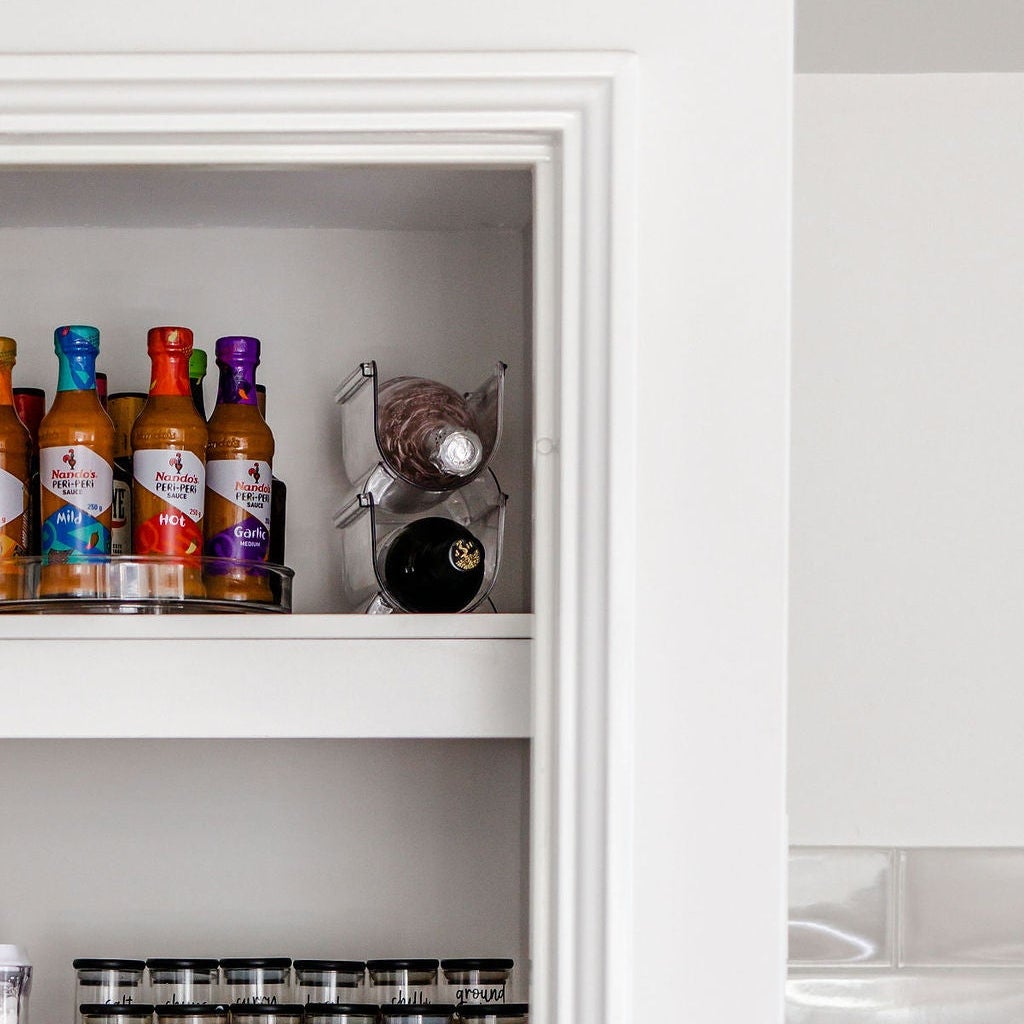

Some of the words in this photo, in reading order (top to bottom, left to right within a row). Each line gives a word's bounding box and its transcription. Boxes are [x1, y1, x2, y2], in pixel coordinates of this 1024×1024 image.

[51, 469, 96, 479] Nando's
[155, 471, 199, 483] Nando's
[247, 501, 264, 509] SAUCE
[56, 509, 82, 525] Mild
[234, 525, 266, 540] Garlic
[456, 984, 506, 1005] ground
